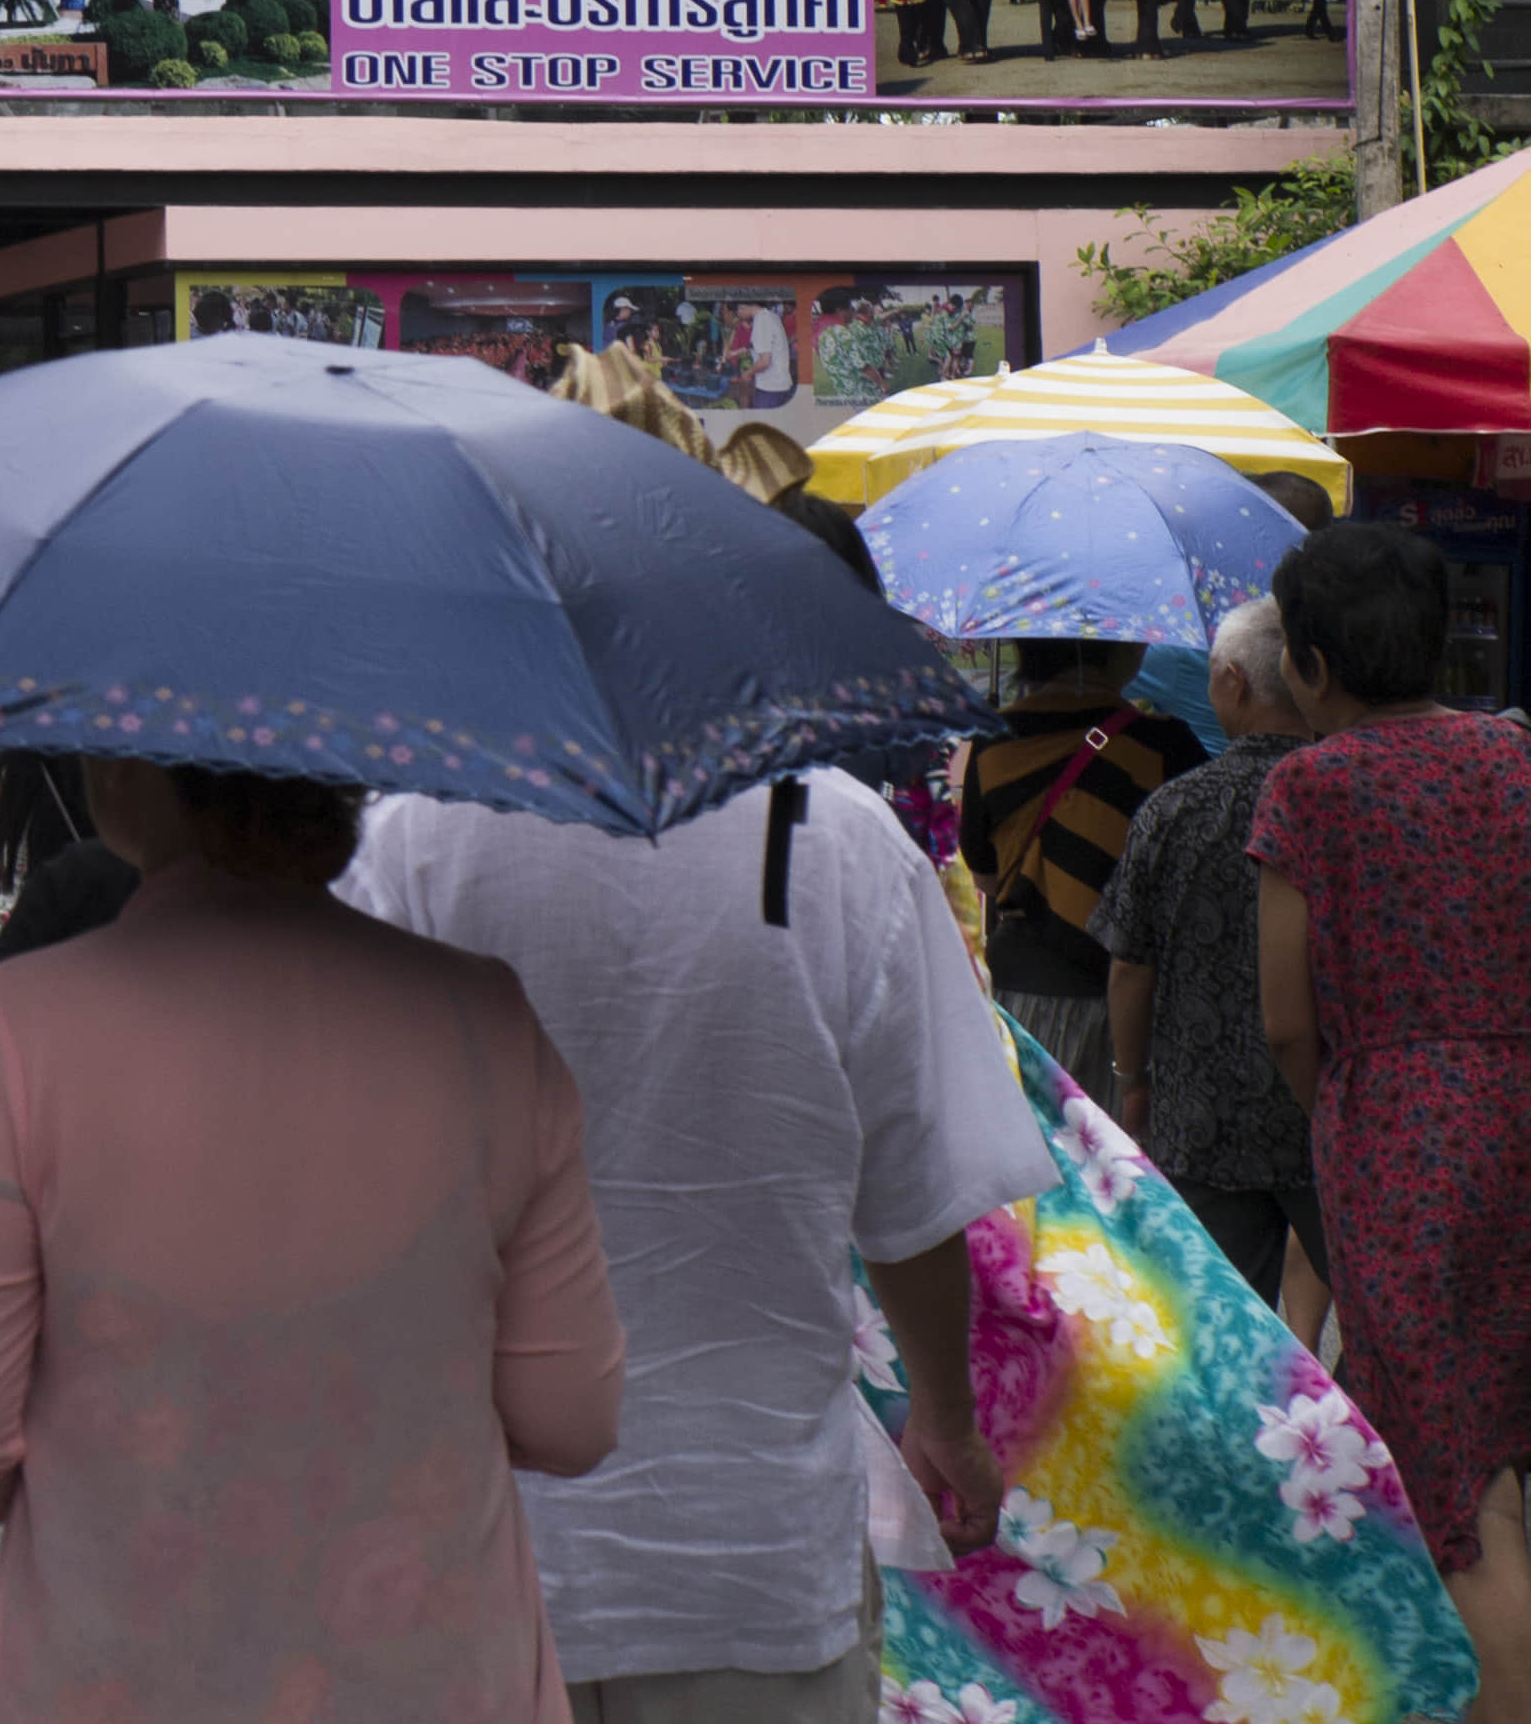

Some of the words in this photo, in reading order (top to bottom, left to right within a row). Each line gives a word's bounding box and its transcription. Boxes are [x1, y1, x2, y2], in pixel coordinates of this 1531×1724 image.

[345, 54, 448, 87] ONE
[473, 55, 618, 88] STOP
[642, 57, 865, 90] SERVICE
